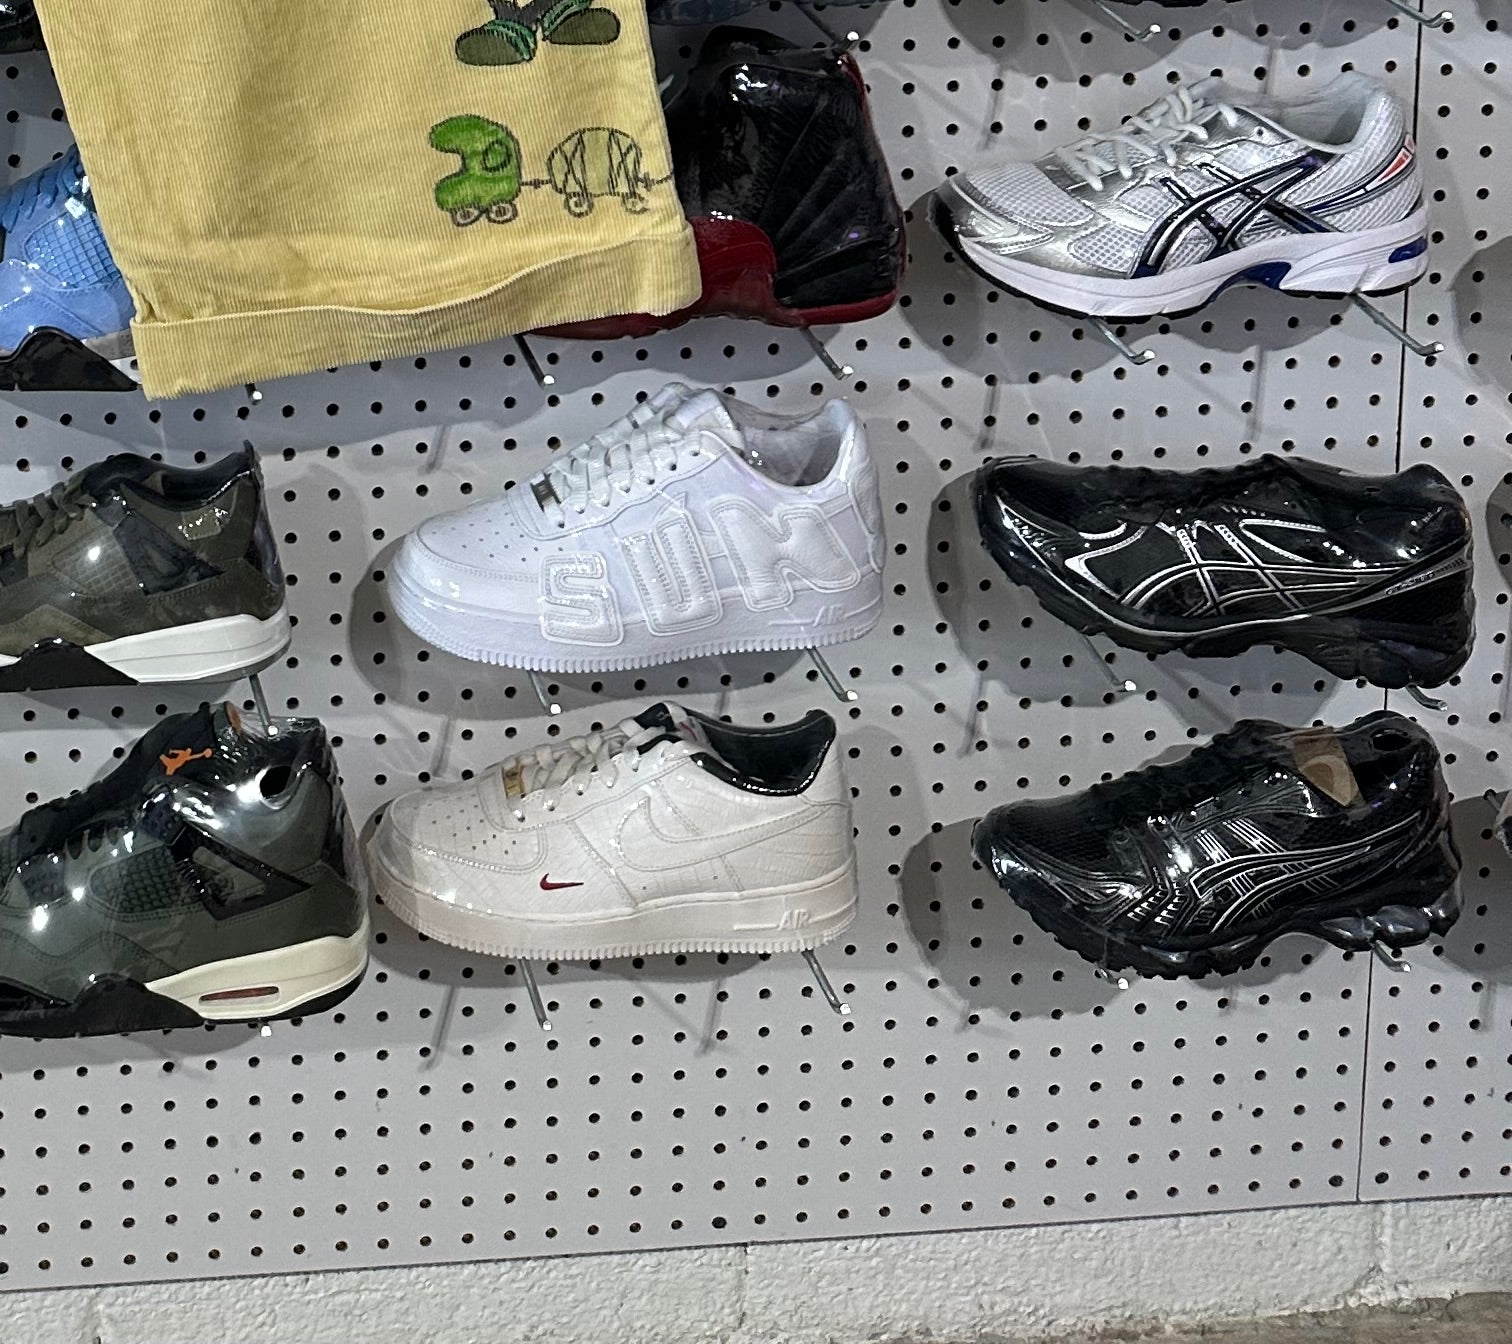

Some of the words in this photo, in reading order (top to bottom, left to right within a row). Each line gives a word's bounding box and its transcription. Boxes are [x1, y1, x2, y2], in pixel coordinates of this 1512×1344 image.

[540, 492, 862, 647] SUN
[813, 603, 847, 627] AIR
[775, 908, 810, 931] AIR
